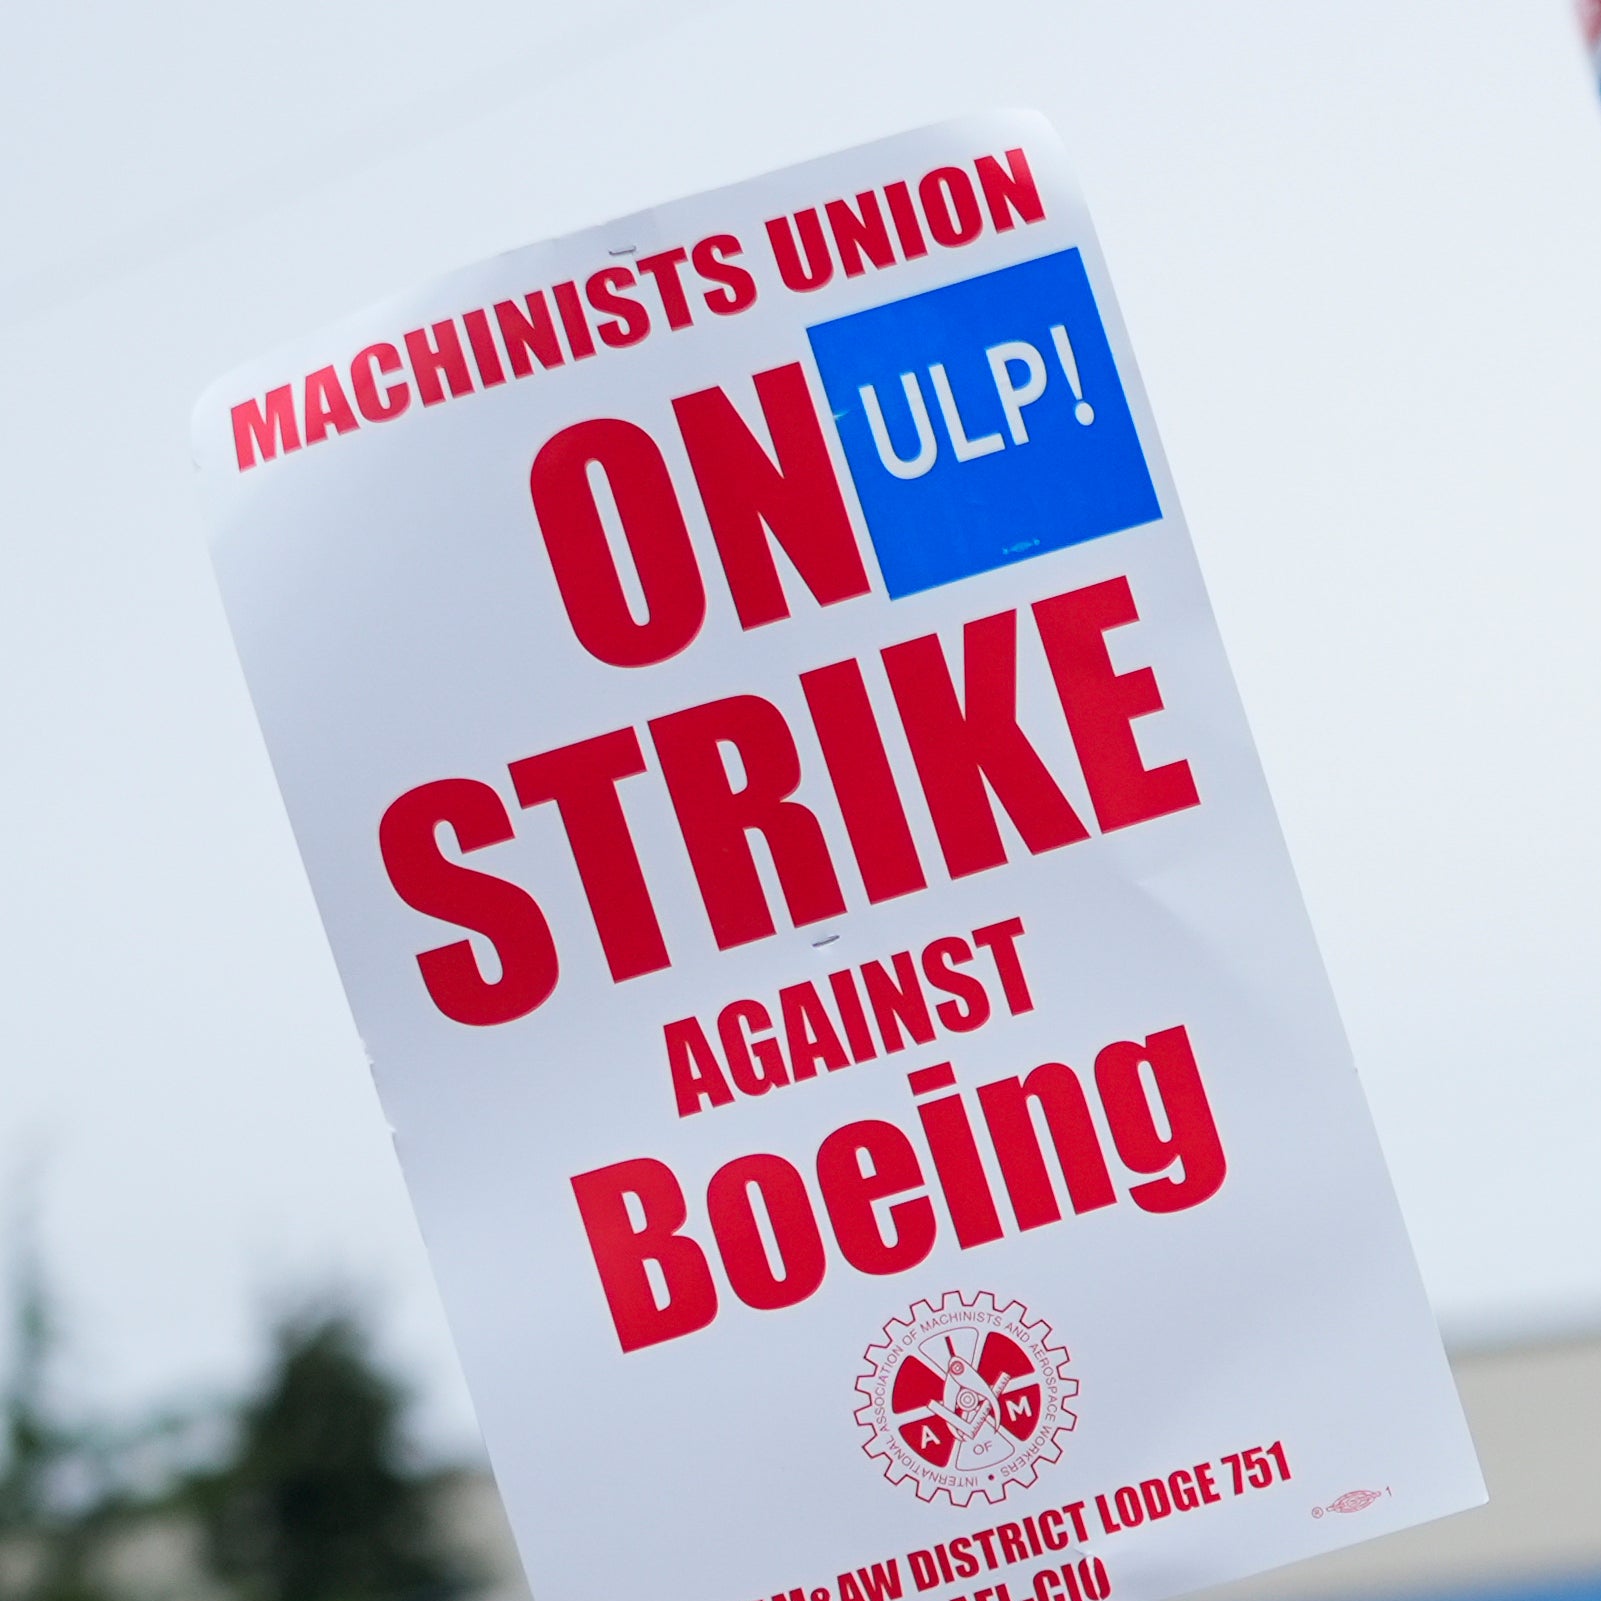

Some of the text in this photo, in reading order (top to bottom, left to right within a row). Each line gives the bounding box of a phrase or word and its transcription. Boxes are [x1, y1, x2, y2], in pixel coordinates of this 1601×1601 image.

[230, 147, 1047, 472] MACHINISTS UNION
[528, 322, 1096, 669] ON ULP!
[376, 575, 1202, 1026] STRIKE
[661, 916, 1035, 1118] AGAINST
[569, 1023, 1227, 1354] Boeing
[874, 1310, 1059, 1488] INTERNATIONAL ASSOCIATION OF MACHINISTS AND AEROSPACE WORKERS
[907, 1500, 1090, 1592] DISTRICT
[1095, 1461, 1222, 1535] LODGE
[1221, 1440, 1292, 1496] 751
[920, 1396, 1033, 1456] A OF M
